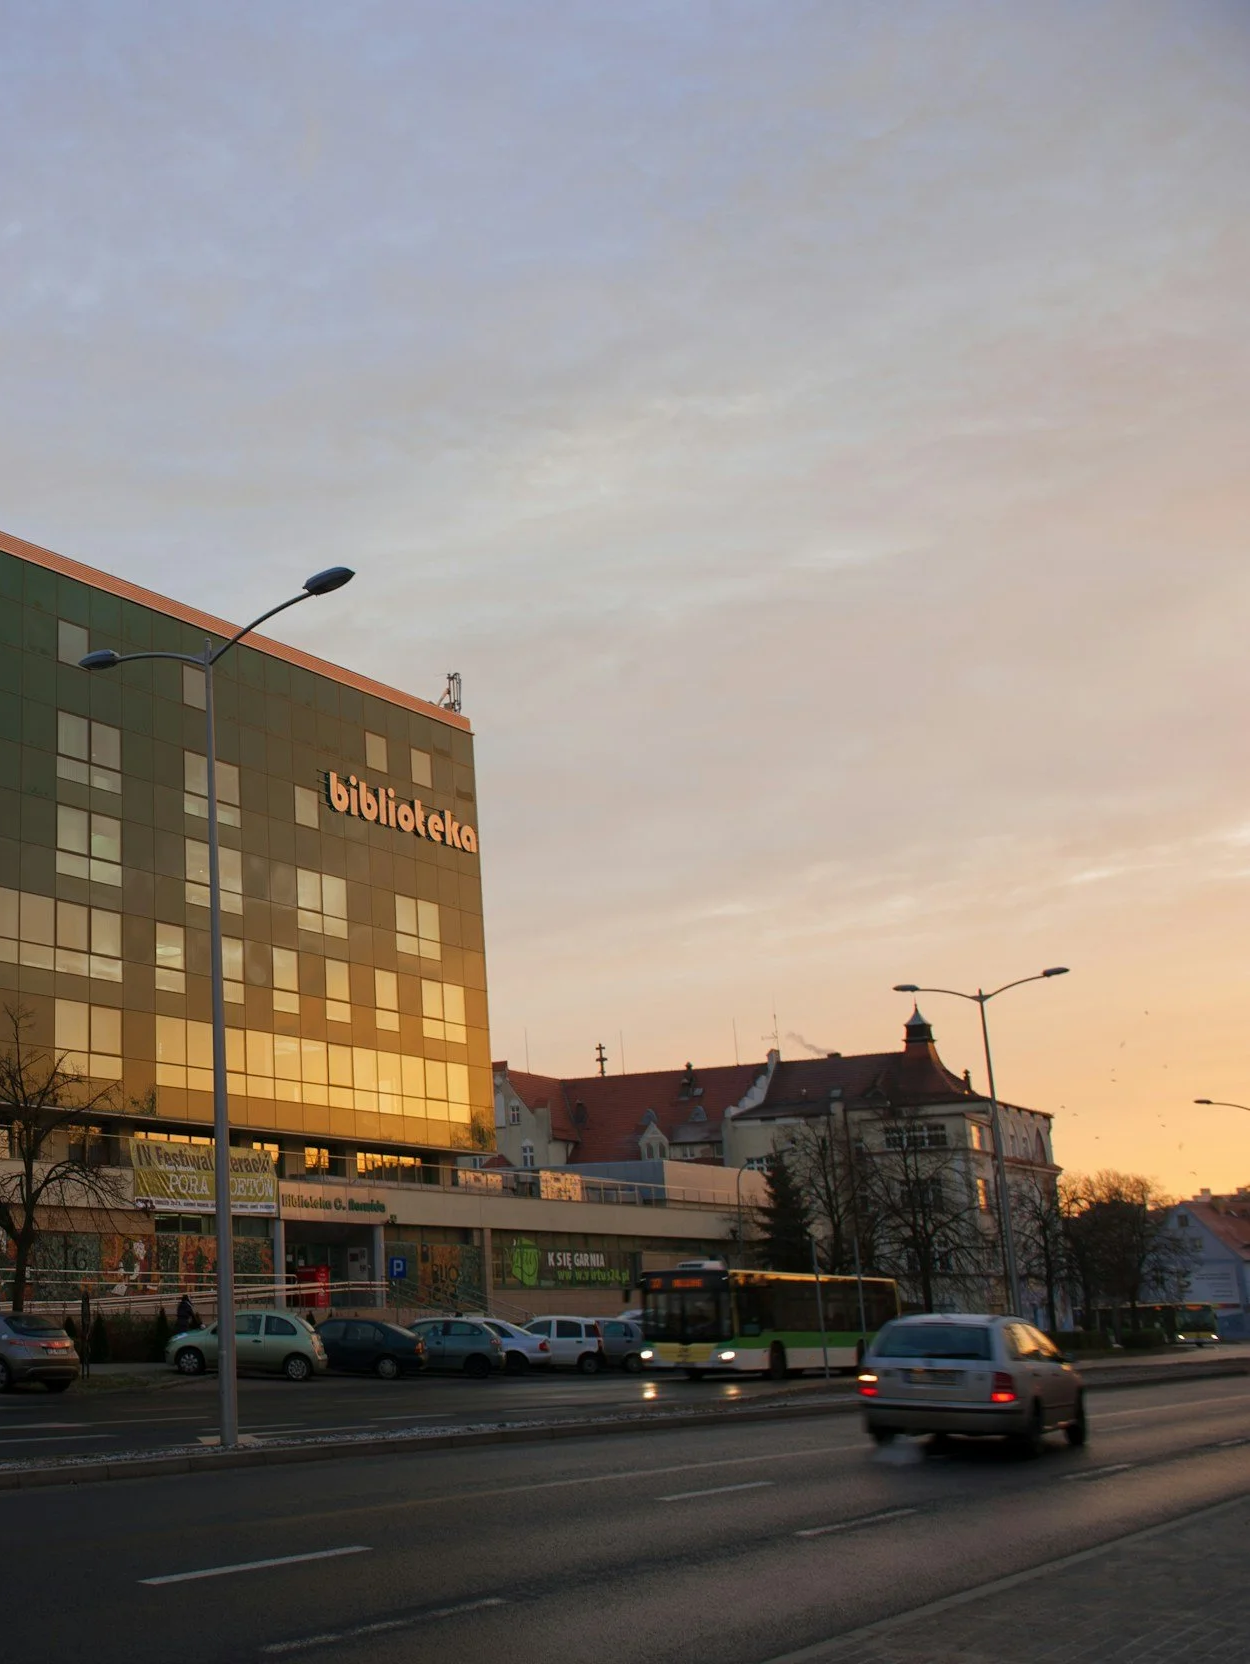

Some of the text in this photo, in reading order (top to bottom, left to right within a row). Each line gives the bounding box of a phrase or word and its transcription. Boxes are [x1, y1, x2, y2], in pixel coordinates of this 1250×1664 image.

[327, 770, 478, 854] biblioteka
[155, 1145, 214, 1172] Festiwal
[167, 1173, 274, 1197] PORA OETÓW
[393, 1260, 404, 1276] P
